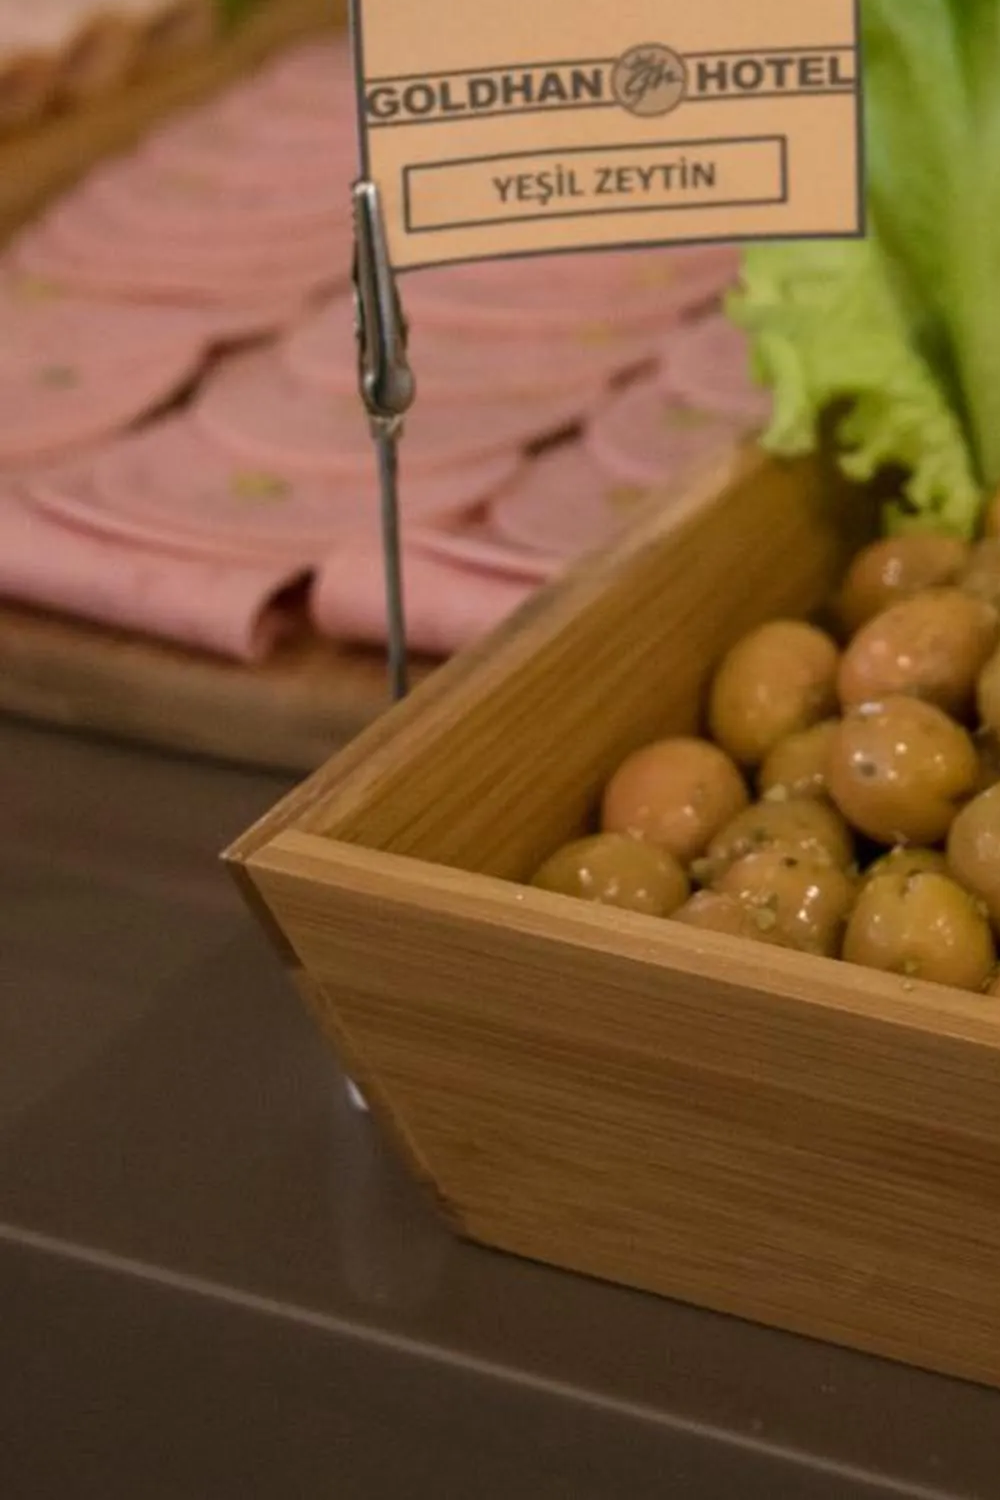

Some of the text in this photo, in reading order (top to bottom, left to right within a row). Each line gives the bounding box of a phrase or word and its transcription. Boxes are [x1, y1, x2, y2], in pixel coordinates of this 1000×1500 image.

[365, 68, 603, 120] GOLDHAN
[698, 56, 856, 92] HOTEL
[492, 157, 717, 206] YEŞİL ZEYTİN
